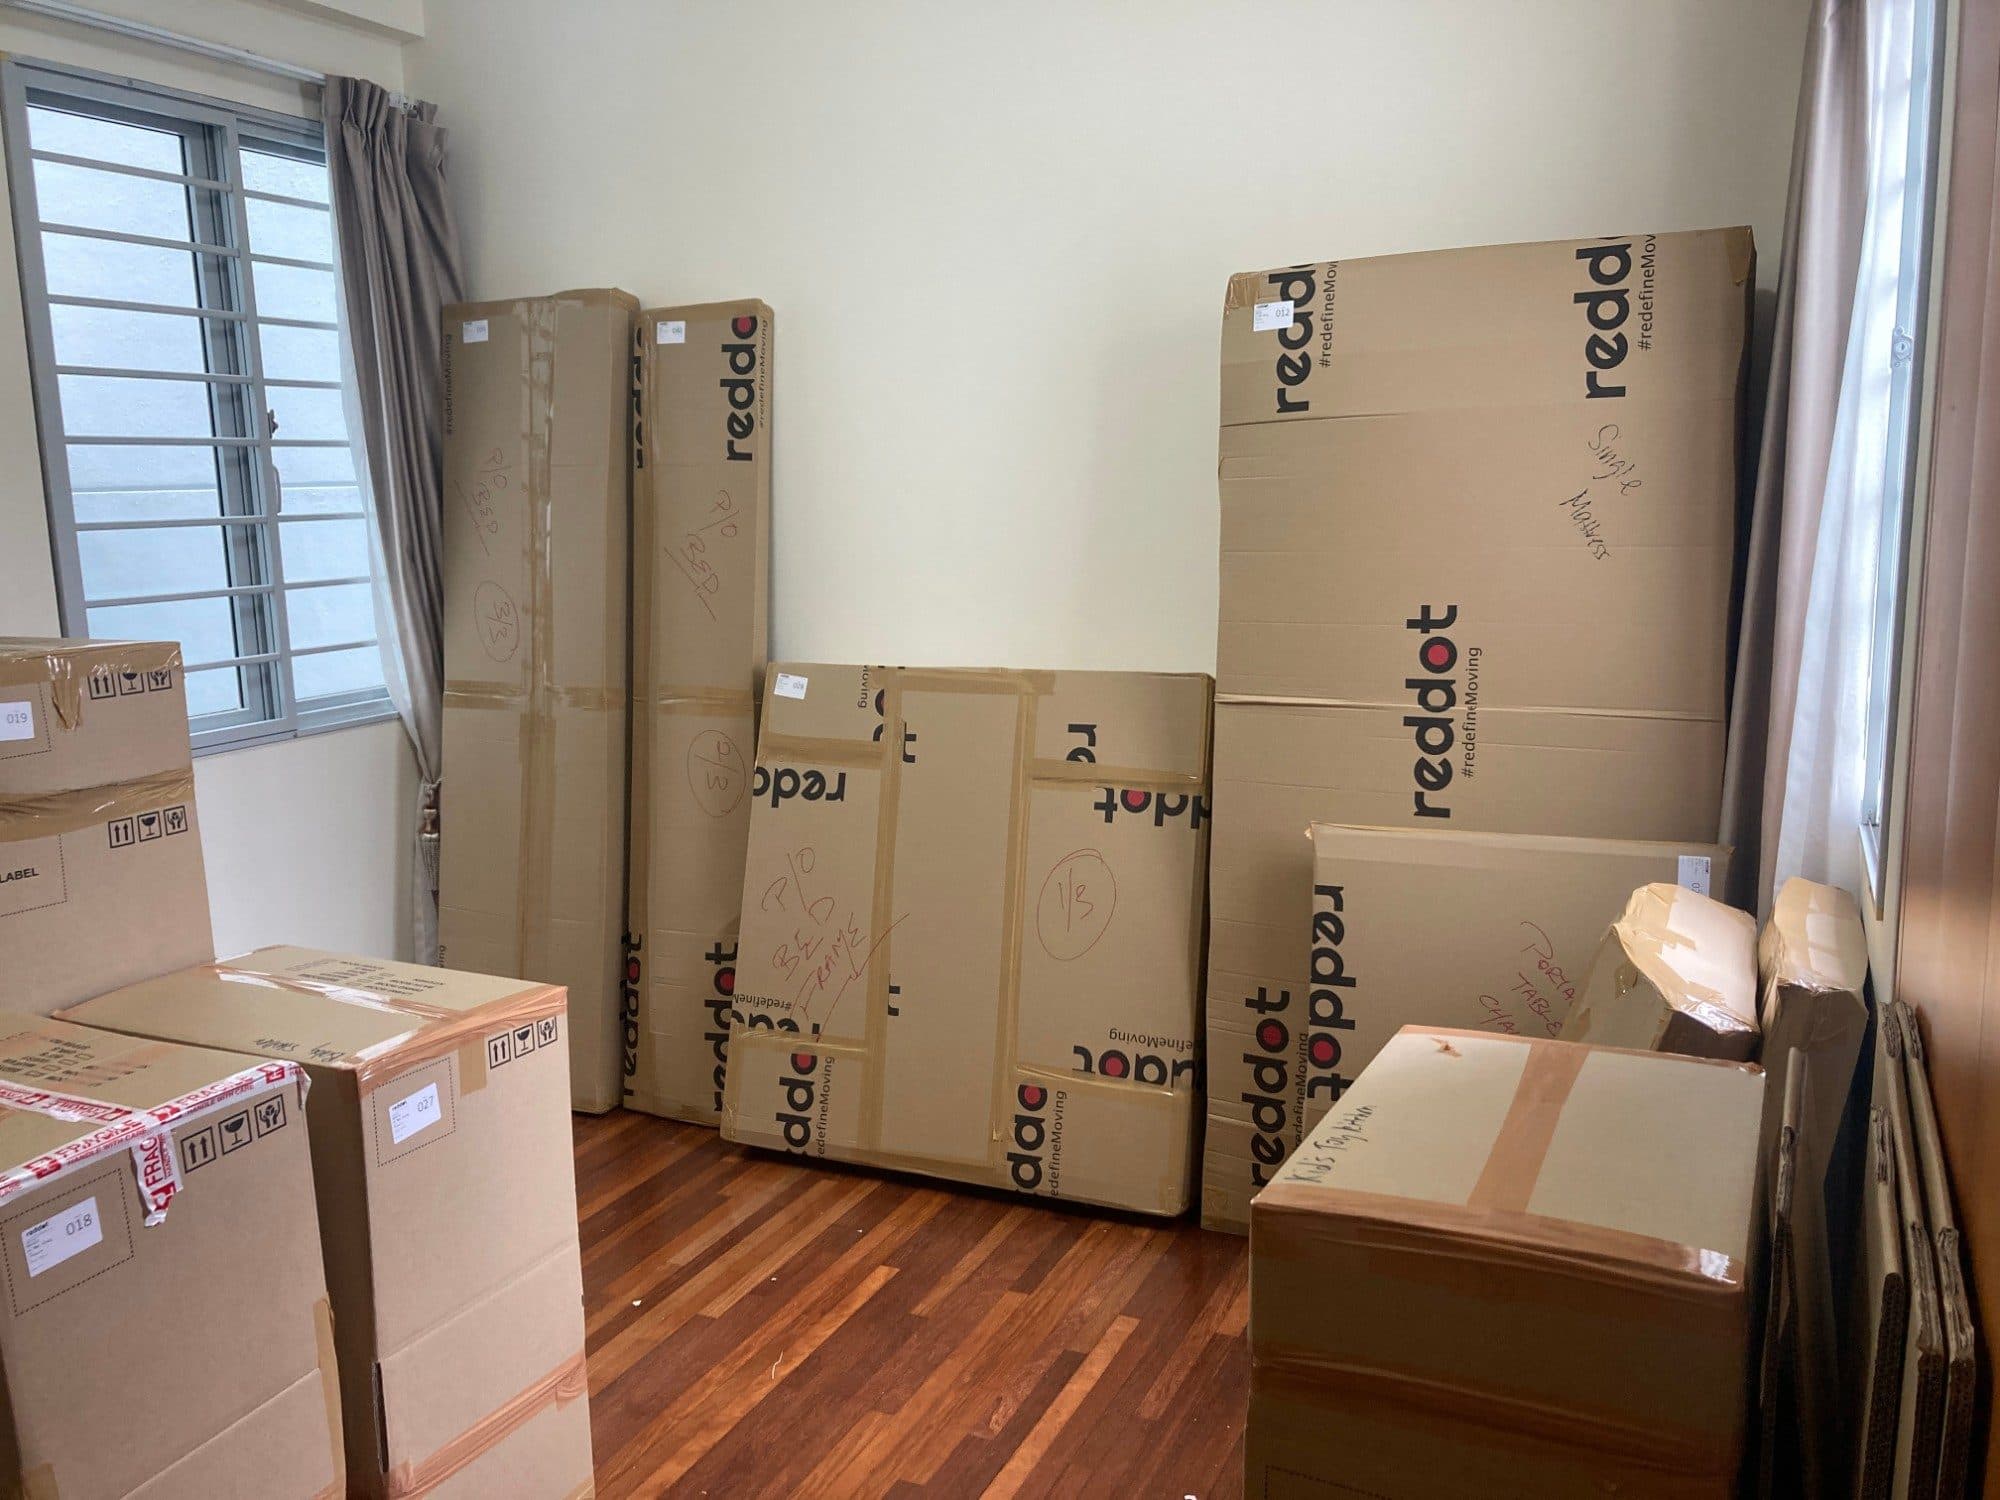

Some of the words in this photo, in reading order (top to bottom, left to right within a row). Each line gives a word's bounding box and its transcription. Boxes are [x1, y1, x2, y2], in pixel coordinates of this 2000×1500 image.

[1574, 235, 1632, 399] redd
[6, 712, 28, 725] 019
[1403, 604, 1458, 818] reddot
[1461, 646, 1482, 779] #redefineMoving
[1307, 885, 1357, 1101] reddot
[1242, 986, 1290, 1187] reddot
[66, 1214, 93, 1236] 018
